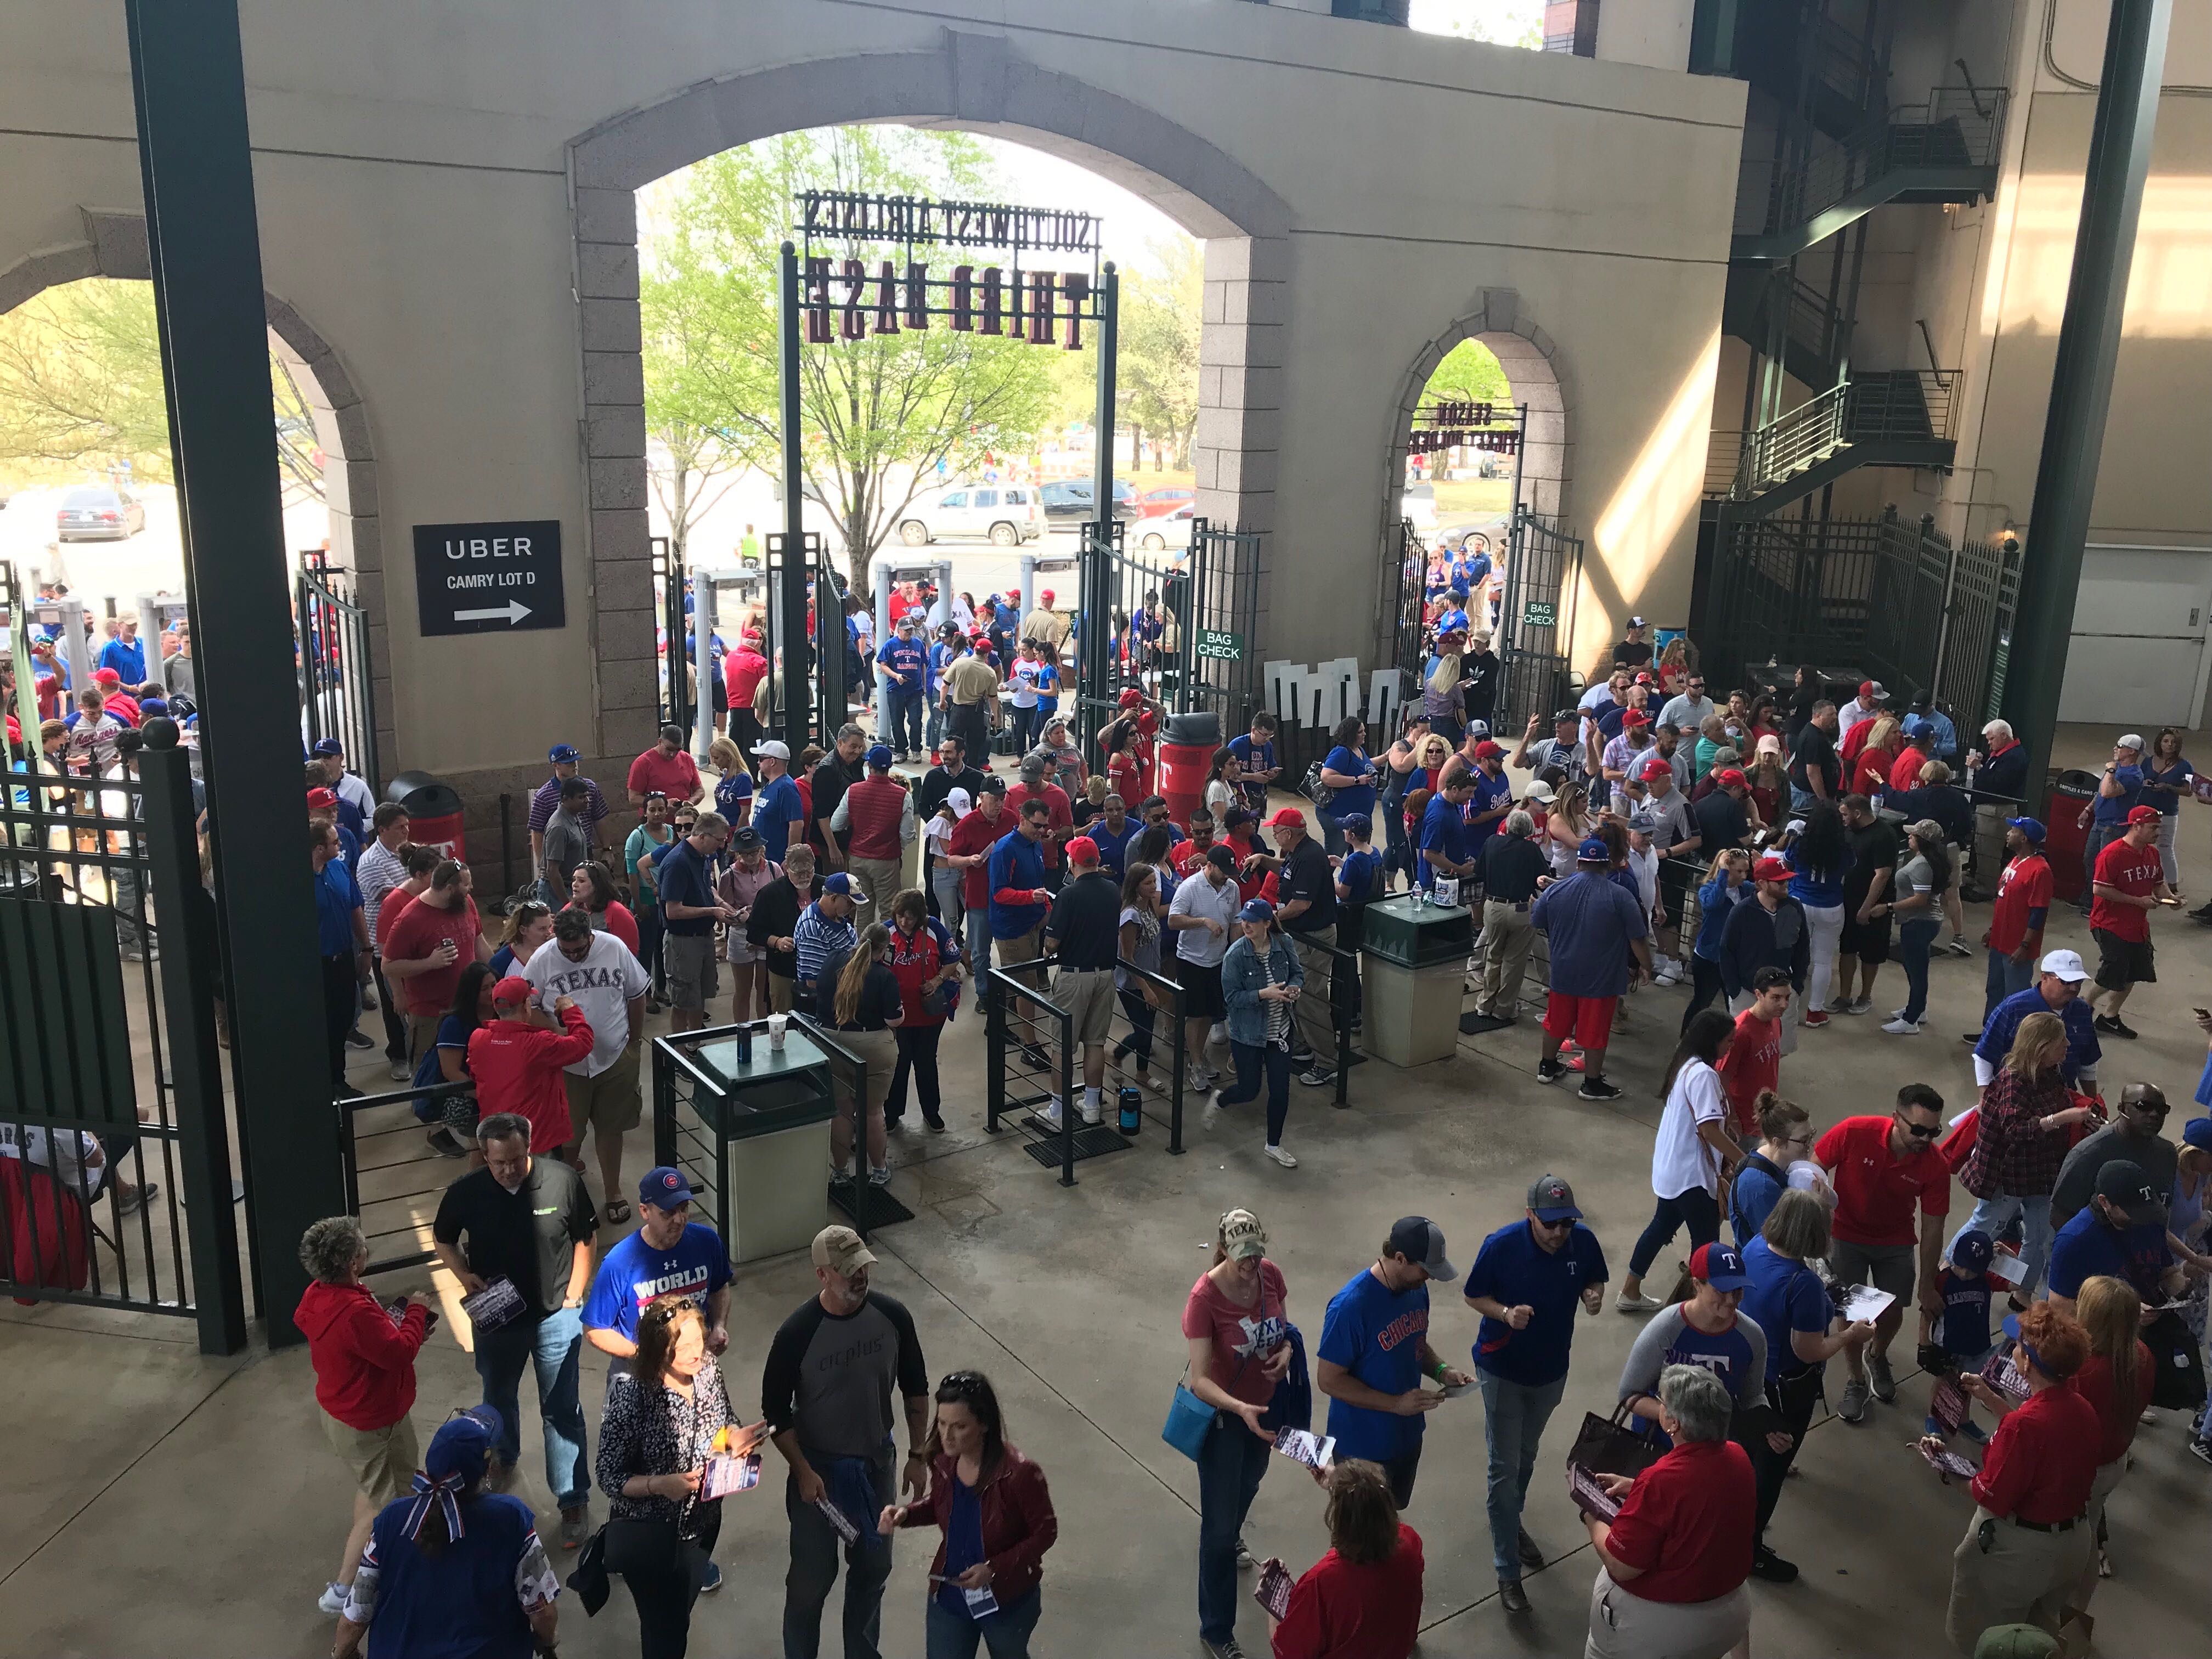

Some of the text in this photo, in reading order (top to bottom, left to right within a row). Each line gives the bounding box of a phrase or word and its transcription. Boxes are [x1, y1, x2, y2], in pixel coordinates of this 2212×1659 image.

[446, 537, 532, 560] UBER
[447, 572, 535, 589] CAMRY LOT D
[1530, 603, 1550, 614] BAG
[1523, 614, 1555, 625] CHECK
[1207, 631, 1232, 646] BAG
[893, 650, 921, 659] TEXAS
[1198, 644, 1240, 659] CHECK
[75, 728, 119, 747] Rangers
[1645, 763, 1651, 771] T
[995, 777, 1002, 786] T
[1160, 761, 1172, 789] T
[324, 790, 332, 799] T
[2062, 785, 2076, 793] BOTTLES
[1776, 860, 1786, 870] T
[2123, 865, 2160, 883] TEXA
[1246, 901, 1255, 910] T
[550, 967, 623, 996] TEXAS
[1754, 1039, 1779, 1063] TEX
[2139, 1186, 2151, 1201] T
[2161, 1192, 2170, 1205] T
[1227, 1222, 1259, 1239] TEXAS
[1567, 1261, 1577, 1275] T
[1722, 1253, 1736, 1269] T
[633, 1265, 708, 1299] WORLD
